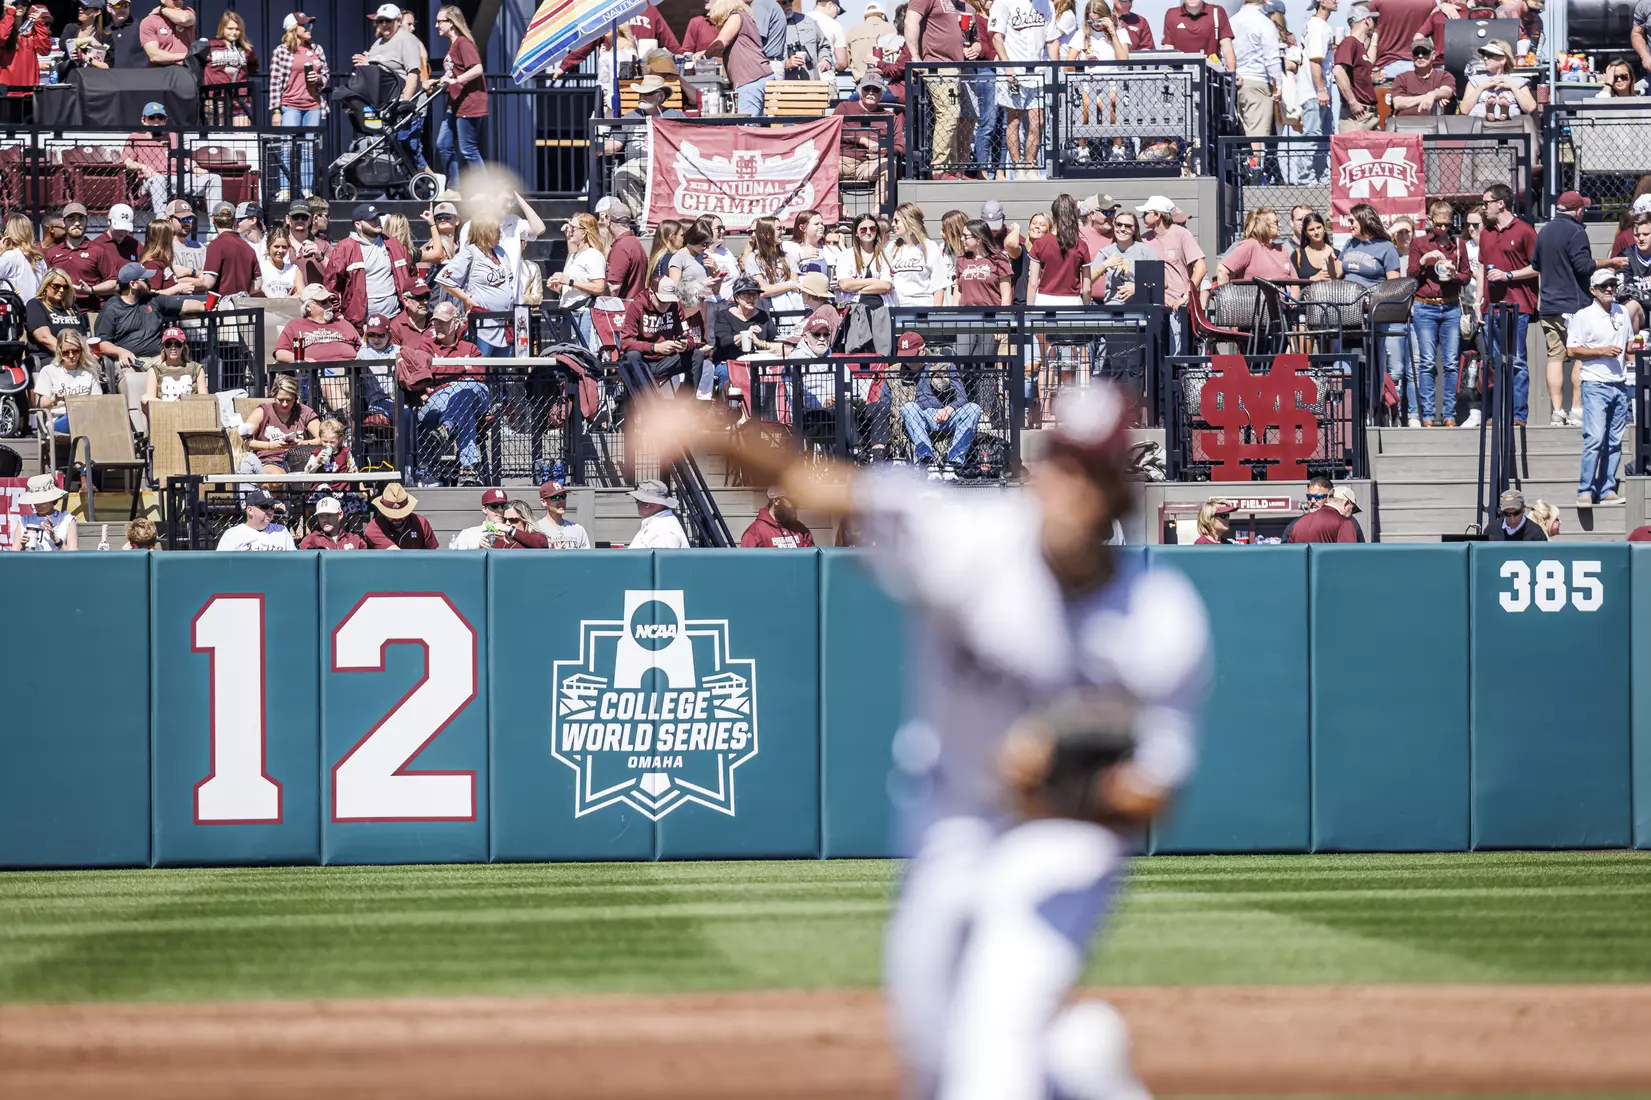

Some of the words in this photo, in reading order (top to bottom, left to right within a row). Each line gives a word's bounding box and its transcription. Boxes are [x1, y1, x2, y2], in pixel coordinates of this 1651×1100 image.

[1352, 163, 1403, 180] STATE
[643, 312, 674, 328] STATE
[1240, 499, 1268, 509] FIELD
[1499, 560, 1603, 612] 385
[635, 624, 678, 639] NCAA
[600, 691, 711, 720] COLLEGE
[562, 723, 653, 751] WORLD
[656, 721, 750, 750] SERIES
[627, 755, 683, 768] OMAHA
